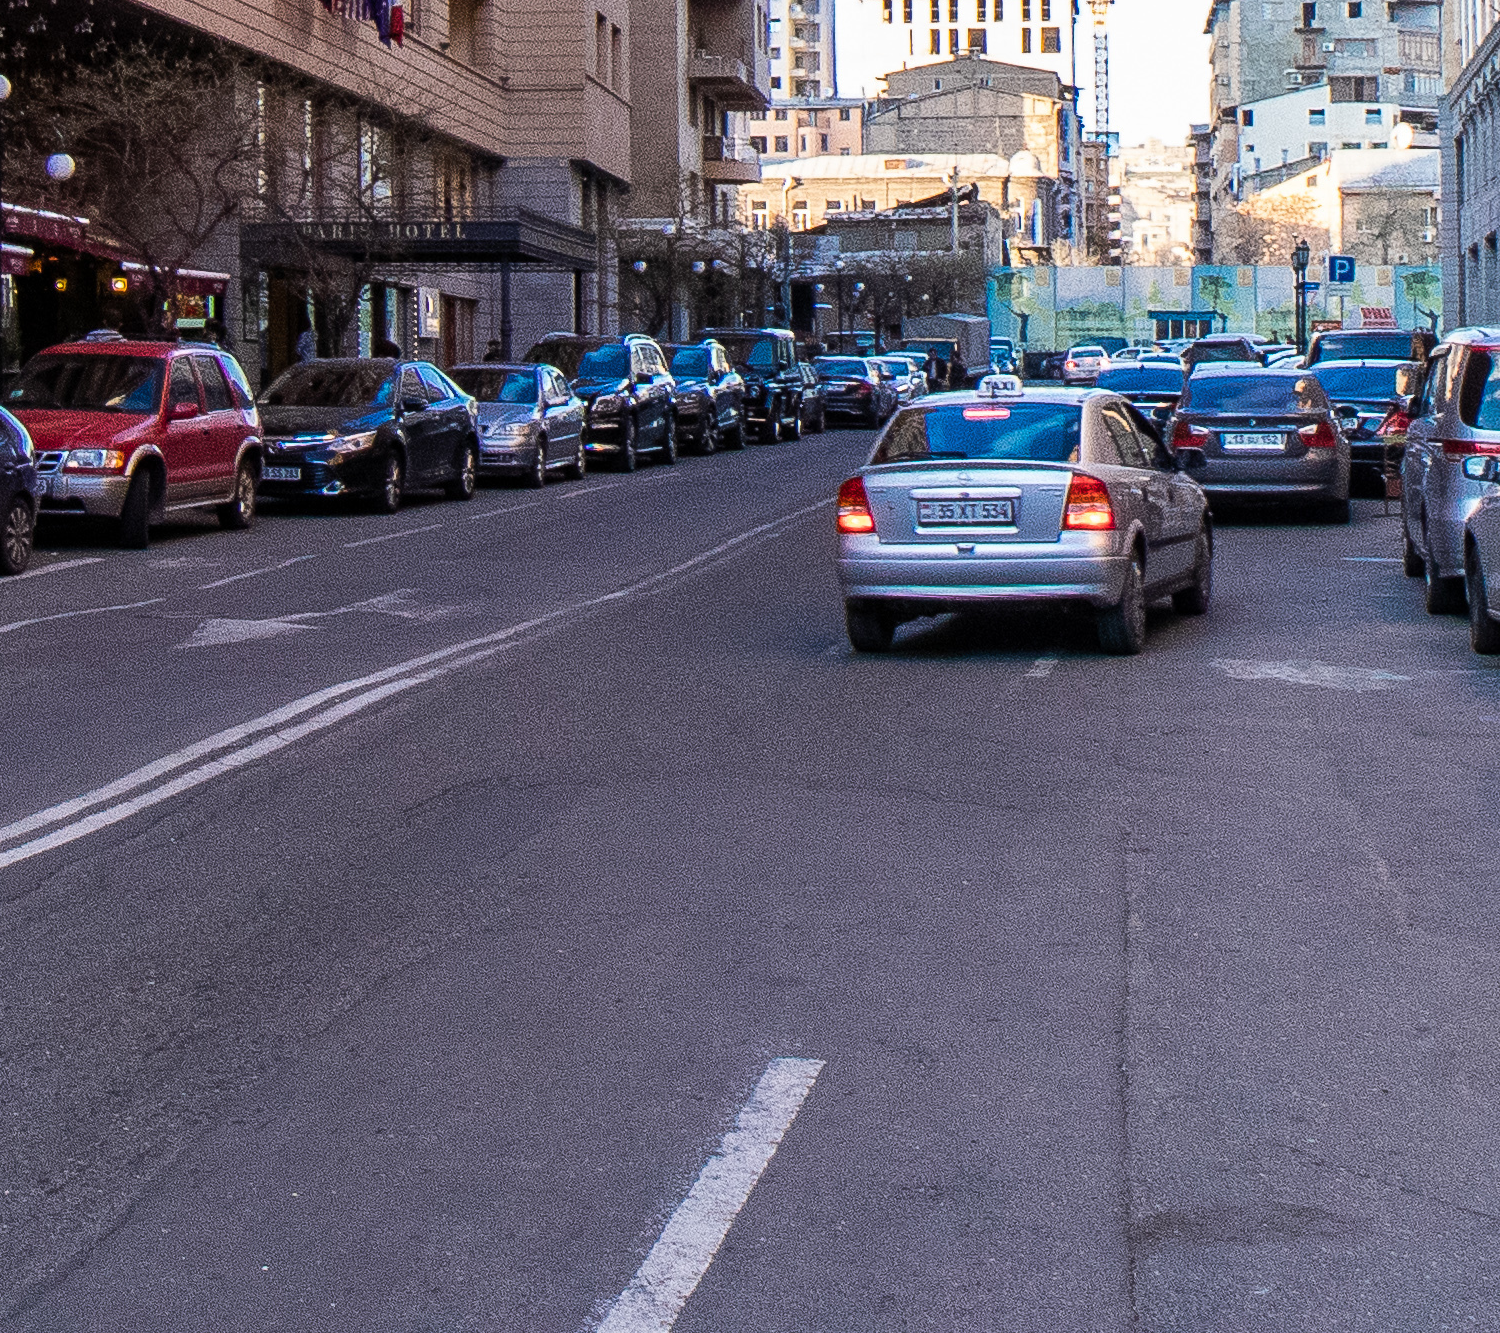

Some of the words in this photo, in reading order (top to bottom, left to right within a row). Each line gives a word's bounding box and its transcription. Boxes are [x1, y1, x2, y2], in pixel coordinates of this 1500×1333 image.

[388, 223, 467, 240] HOTEL
[1336, 259, 1351, 281] P
[984, 380, 1016, 393] TAXI
[938, 504, 955, 519] 35
